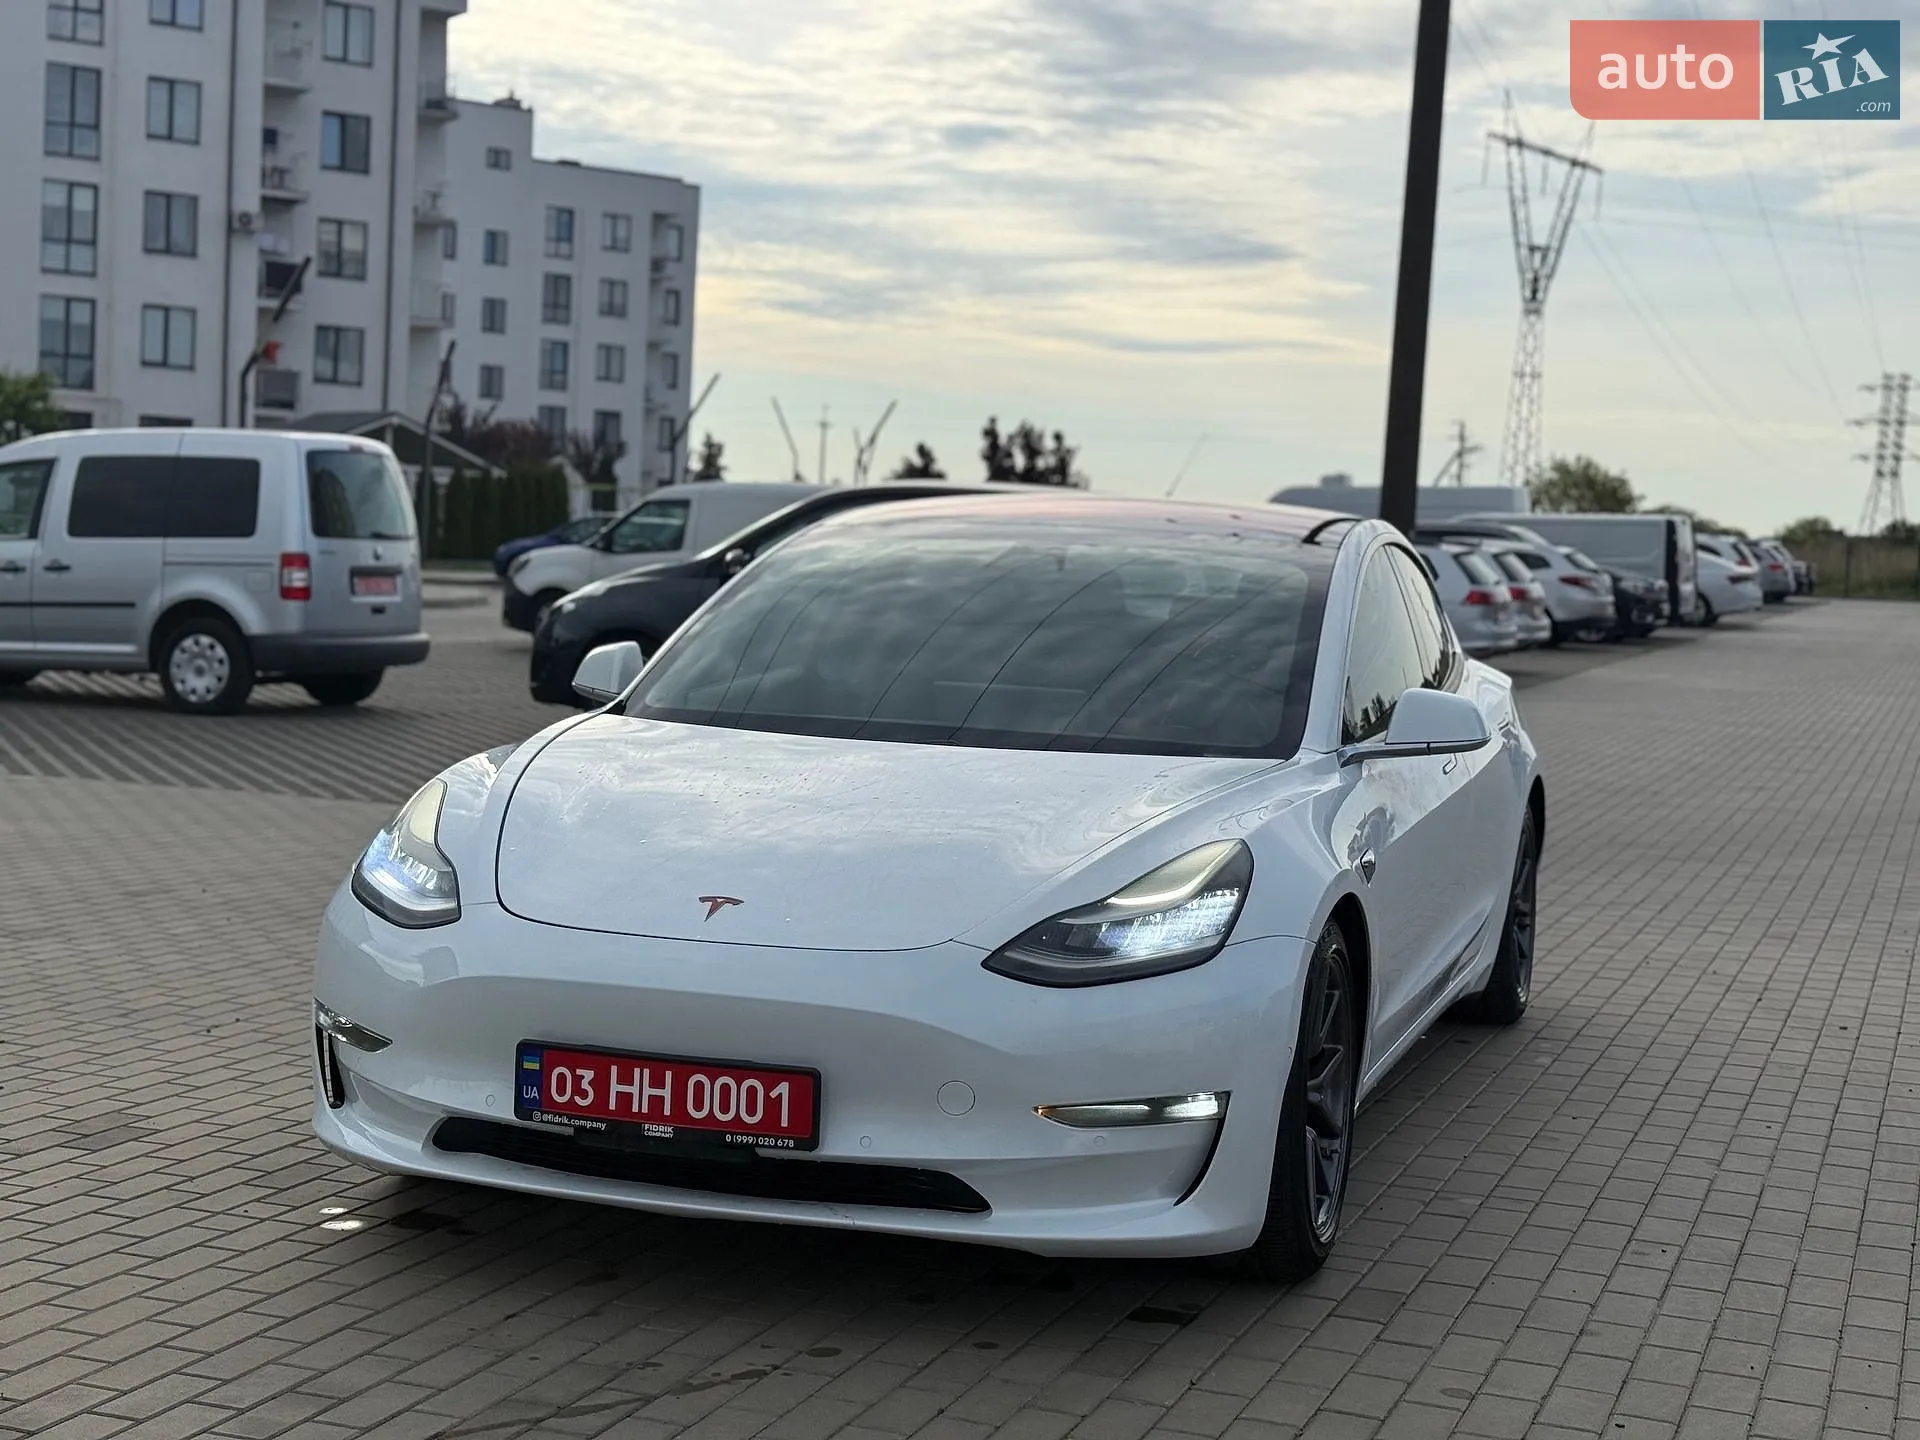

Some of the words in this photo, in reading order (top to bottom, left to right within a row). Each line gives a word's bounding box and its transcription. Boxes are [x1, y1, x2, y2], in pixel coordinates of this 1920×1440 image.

[523, 1085, 540, 1100] UA
[550, 1066, 595, 1107] 03
[608, 1065, 672, 1116] HH
[686, 1073, 790, 1127] 0001
[542, 1113, 607, 1131] @fidrik.company
[644, 1123, 674, 1133] FIDRIK
[644, 1131, 674, 1139] COMPANY
[725, 1134, 732, 1142] 0
[733, 1135, 756, 1145] (999)
[758, 1137, 775, 1146] 020
[777, 1138, 795, 1148] 678
